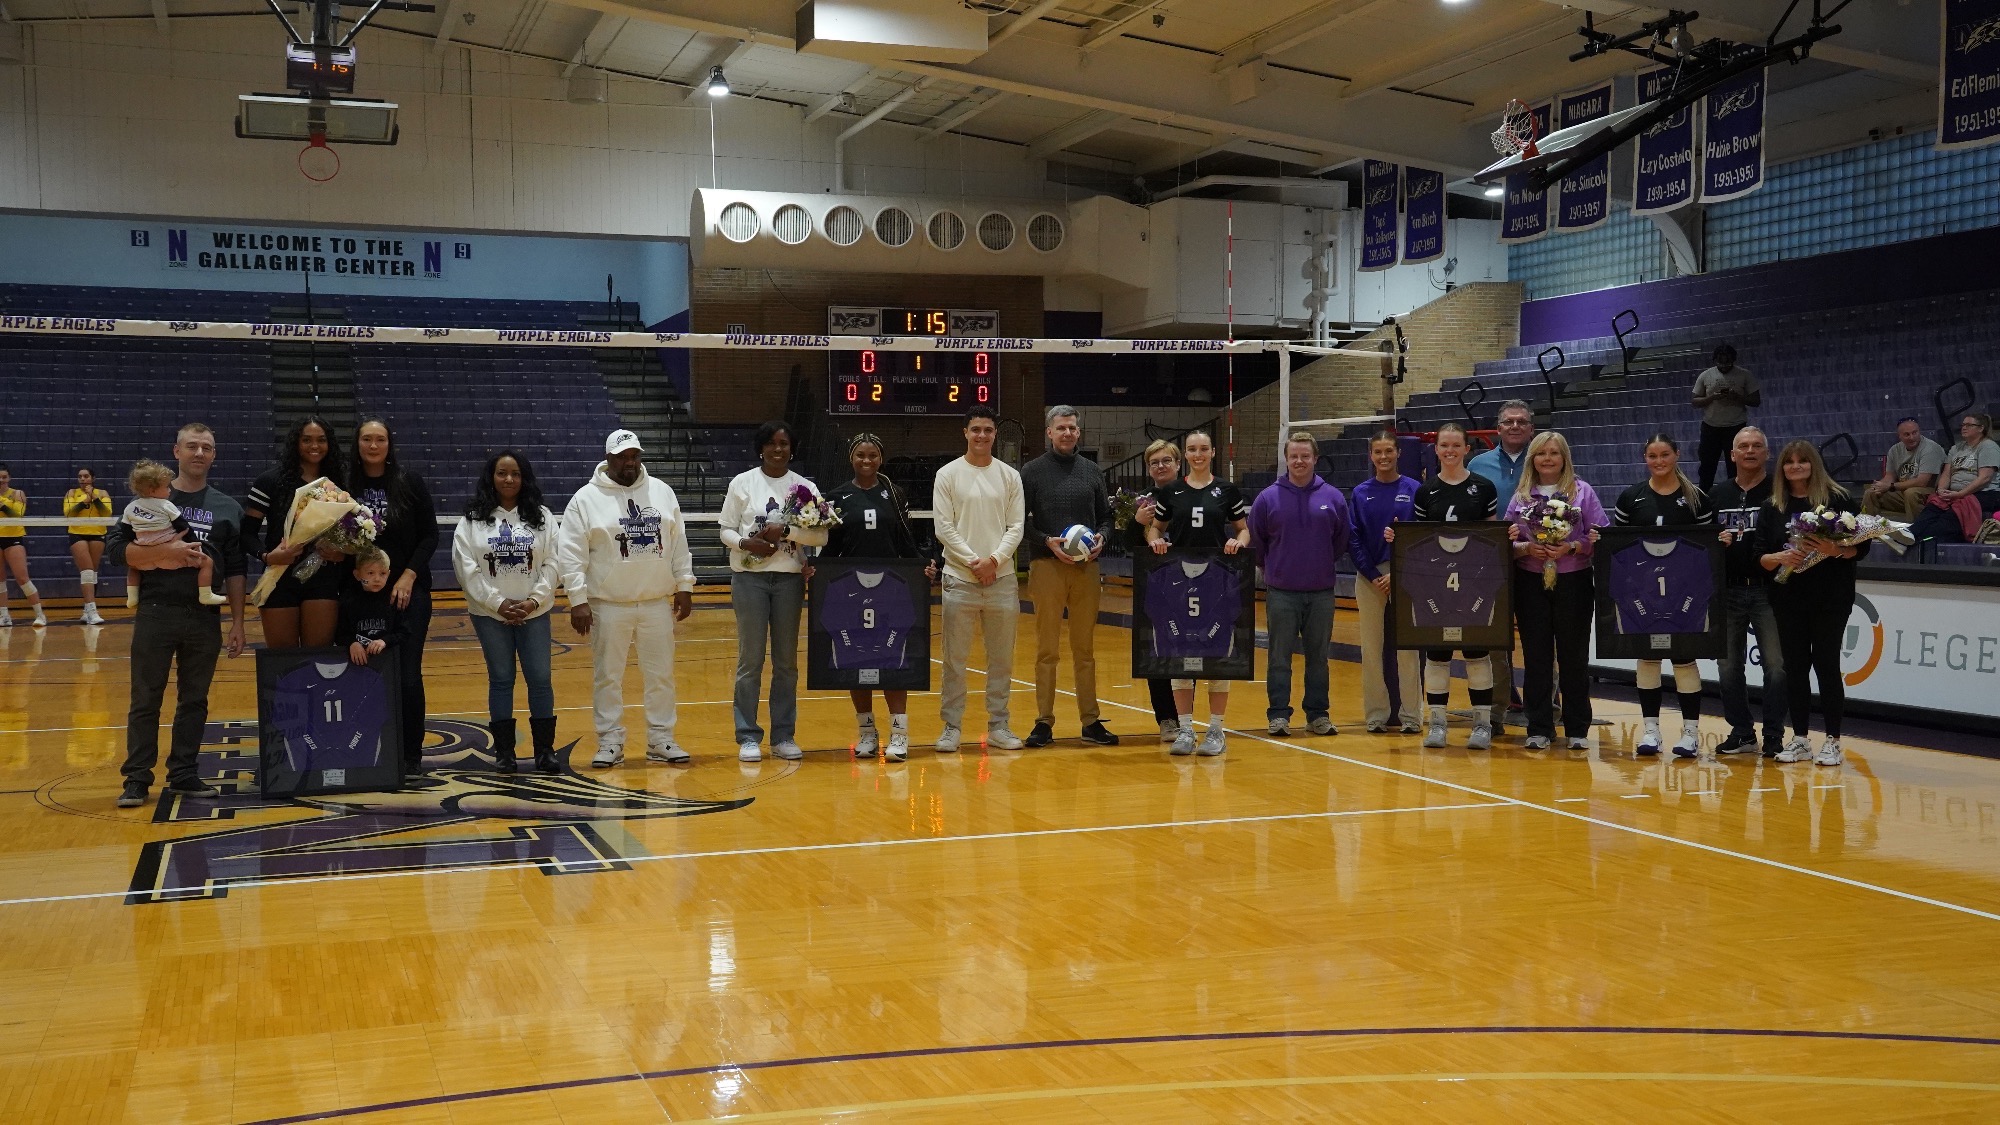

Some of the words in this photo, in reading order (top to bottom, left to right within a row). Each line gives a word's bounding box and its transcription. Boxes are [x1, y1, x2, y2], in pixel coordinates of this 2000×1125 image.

[1568, 96, 1602, 121] NIAGARA
[136, 231, 145, 246] 8
[168, 229, 187, 262] N
[213, 232, 322, 253] WELCOME
[329, 237, 357, 254] TO
[365, 239, 404, 256] THE
[198, 251, 326, 273] GALLAGHER
[335, 257, 415, 276] CENTER
[424, 242, 441, 273] N
[1, 316, 47, 330] RPLE
[51, 318, 115, 332] EAGLES
[251, 324, 313, 337] PURPLE
[317, 326, 375, 338] EAGLES
[907, 312, 946, 334] 1:15
[498, 330, 555, 342] PURPLE
[557, 331, 612, 343] EAGLES
[725, 334, 777, 346] PURPLE
[780, 335, 830, 347] EAGLES
[935, 338, 982, 349] PURPLE
[985, 339, 1034, 350] EAGLES
[1132, 340, 1178, 351] PURPLE
[1181, 340, 1224, 351] EAGLES
[862, 351, 875, 373] 0
[975, 353, 988, 374] 0
[838, 375, 860, 383] FOULS
[846, 384, 857, 401] 0
[872, 384, 882, 402] 2
[948, 385, 959, 402] 2
[977, 385, 988, 402] 0
[904, 405, 927, 413] MATCH
[864, 508, 877, 530] 9
[1191, 506, 1204, 528] 5
[1446, 572, 1460, 592] 4
[1657, 576, 1666, 596] 1
[1188, 596, 1200, 617] 5
[863, 608, 875, 629] 9
[1893, 629, 1999, 673] LEGE
[323, 699, 343, 723] 11
